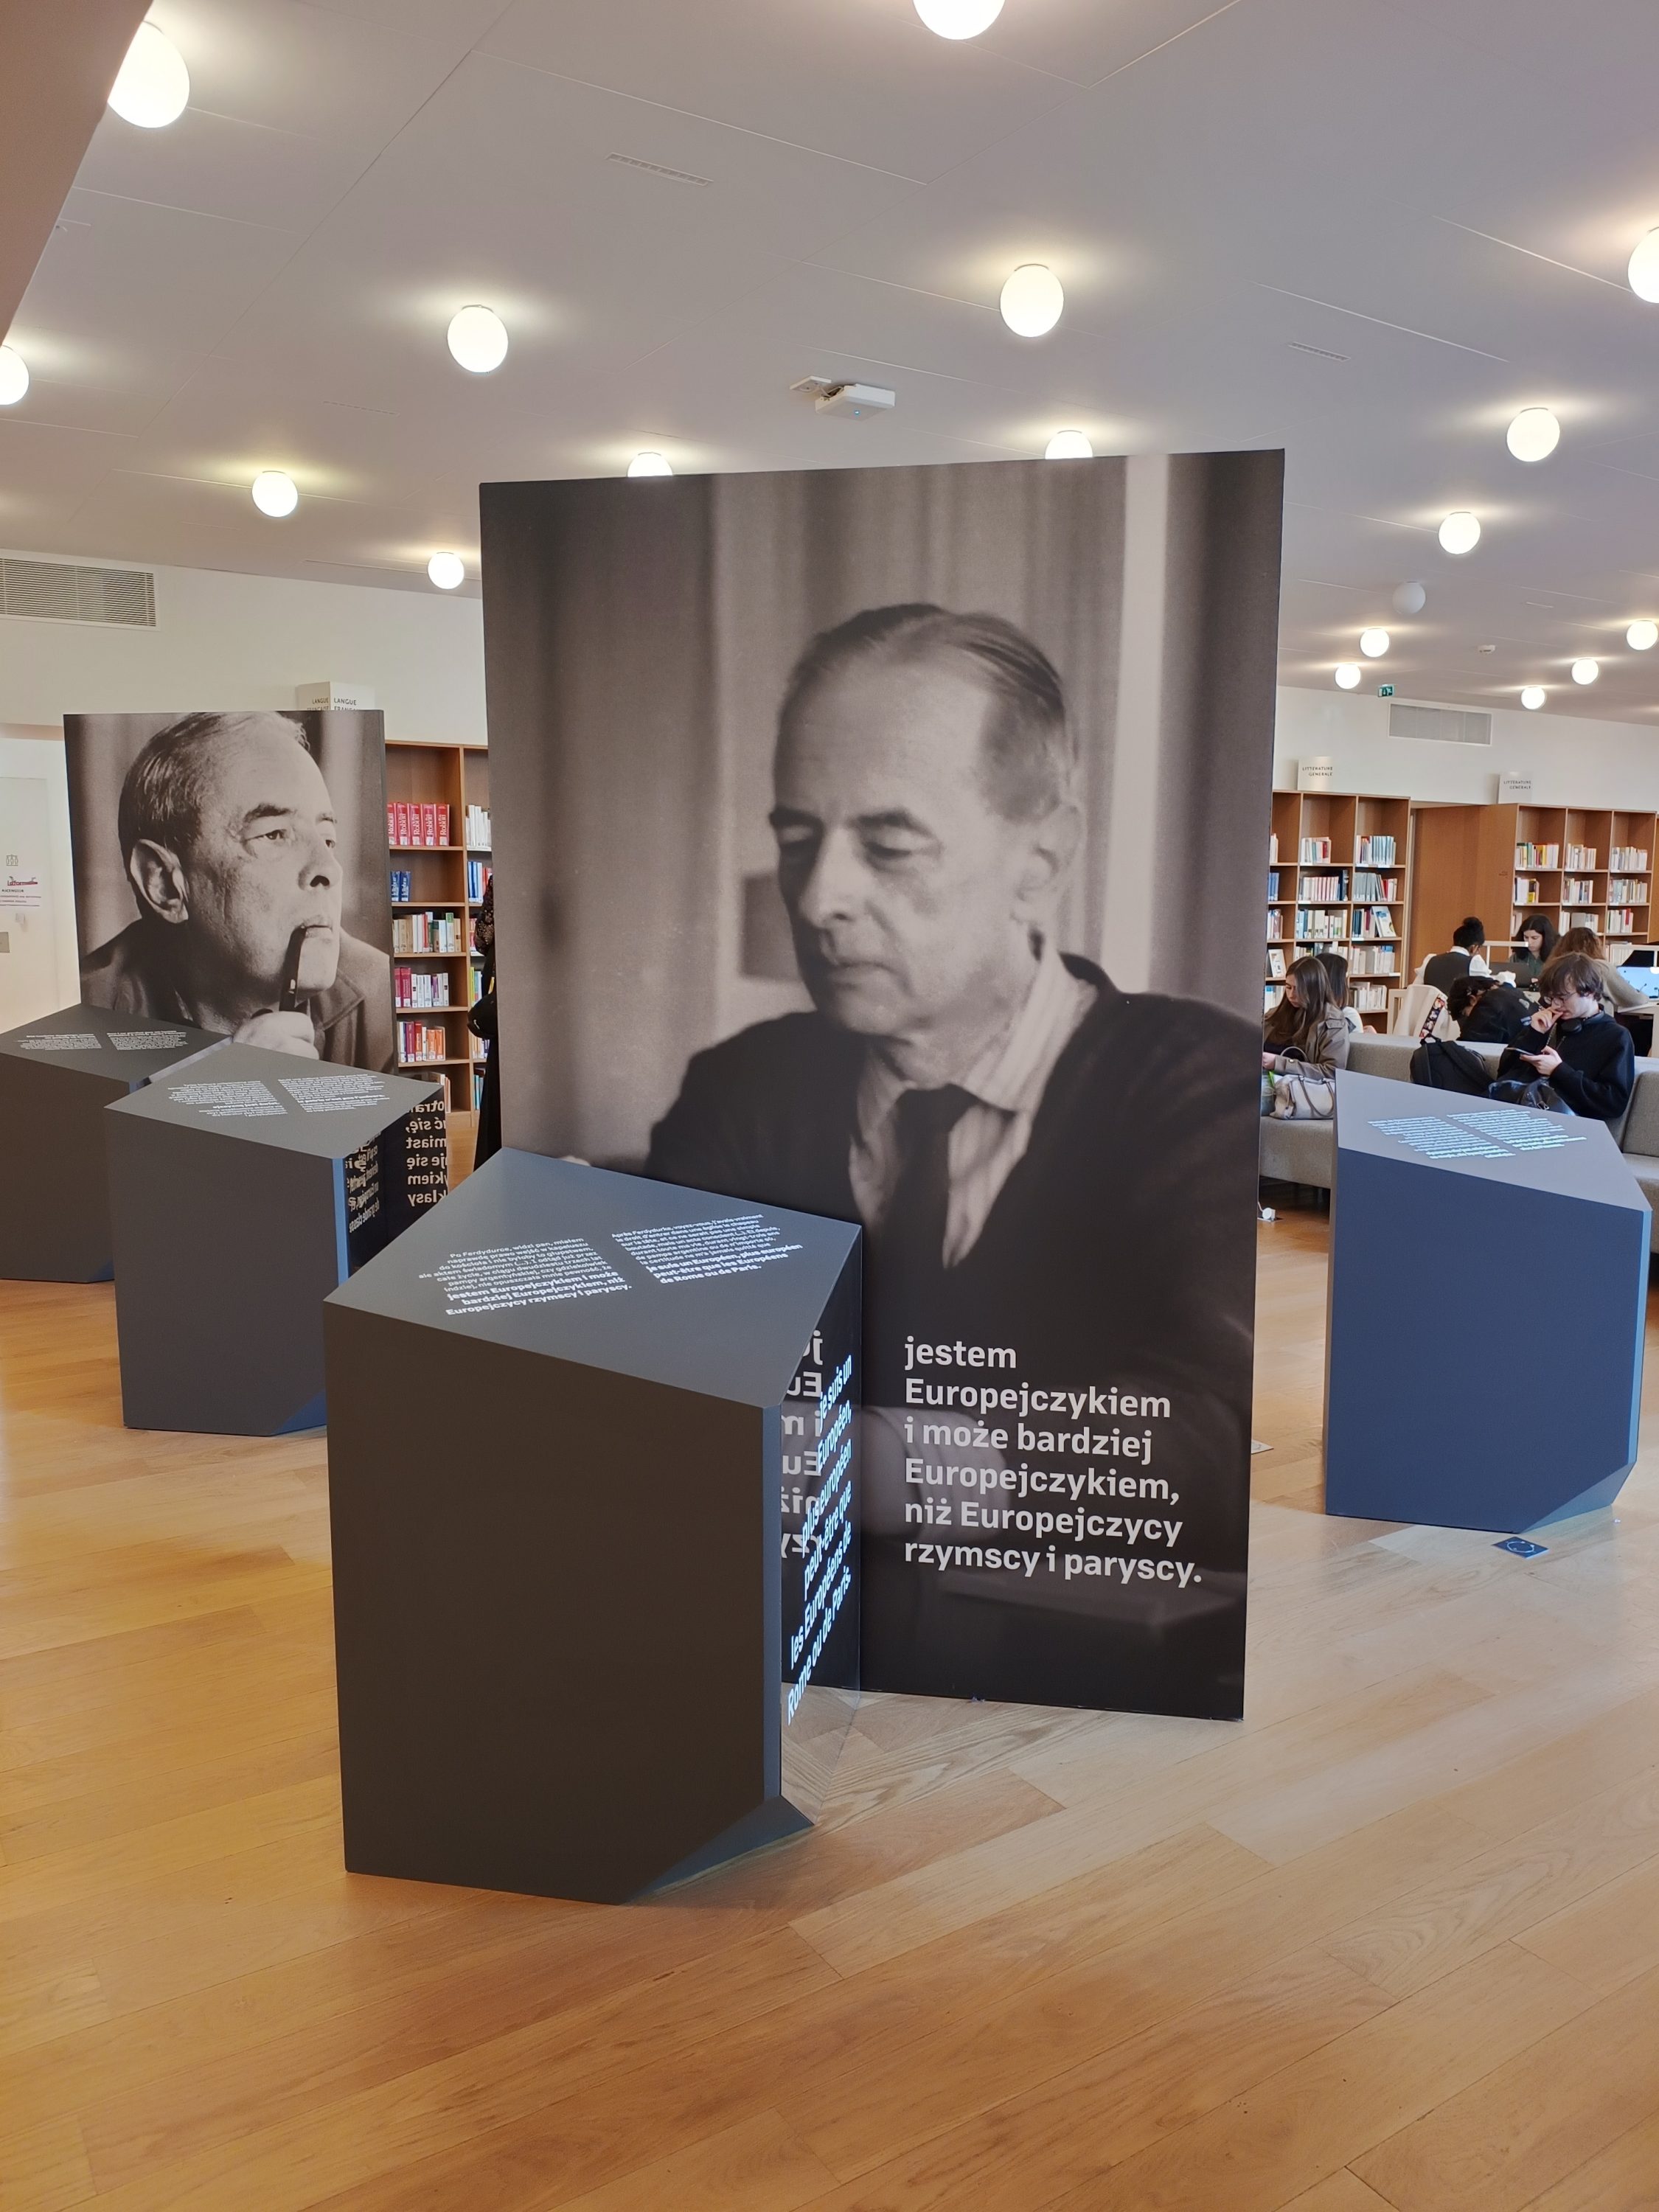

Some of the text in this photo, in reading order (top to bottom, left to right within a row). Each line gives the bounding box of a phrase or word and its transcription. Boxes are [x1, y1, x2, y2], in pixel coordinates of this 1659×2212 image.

[334, 698, 357, 706] LANGUE
[446, 1299, 526, 1315] Europejczycy
[528, 1292, 577, 1303] rzymscy
[584, 1284, 631, 1295] paryscy.
[447, 1290, 490, 1301] jestem
[490, 1277, 582, 1293] Europejczykiem
[588, 1271, 618, 1279] może
[462, 1293, 512, 1304] bardziej
[512, 1281, 607, 1297] Europejczykiem,
[905, 1335, 1017, 1370] jestem
[819, 1354, 852, 1433] je suis un
[905, 1377, 1171, 1419] Europejczykiem
[817, 1399, 852, 1473] Européen,
[905, 1416, 1152, 1465] i może bardziej
[802, 1439, 852, 1559] plus européen
[905, 1457, 1180, 1505] Europejczykiem,
[804, 1480, 852, 1601] peut-être que
[905, 1498, 1183, 1547] niż Europejczycy
[905, 1541, 1202, 1588] rzymscy i paryscy.
[790, 1520, 852, 1670] les Européens de
[787, 1565, 852, 1726] Rome ou de Paris.
